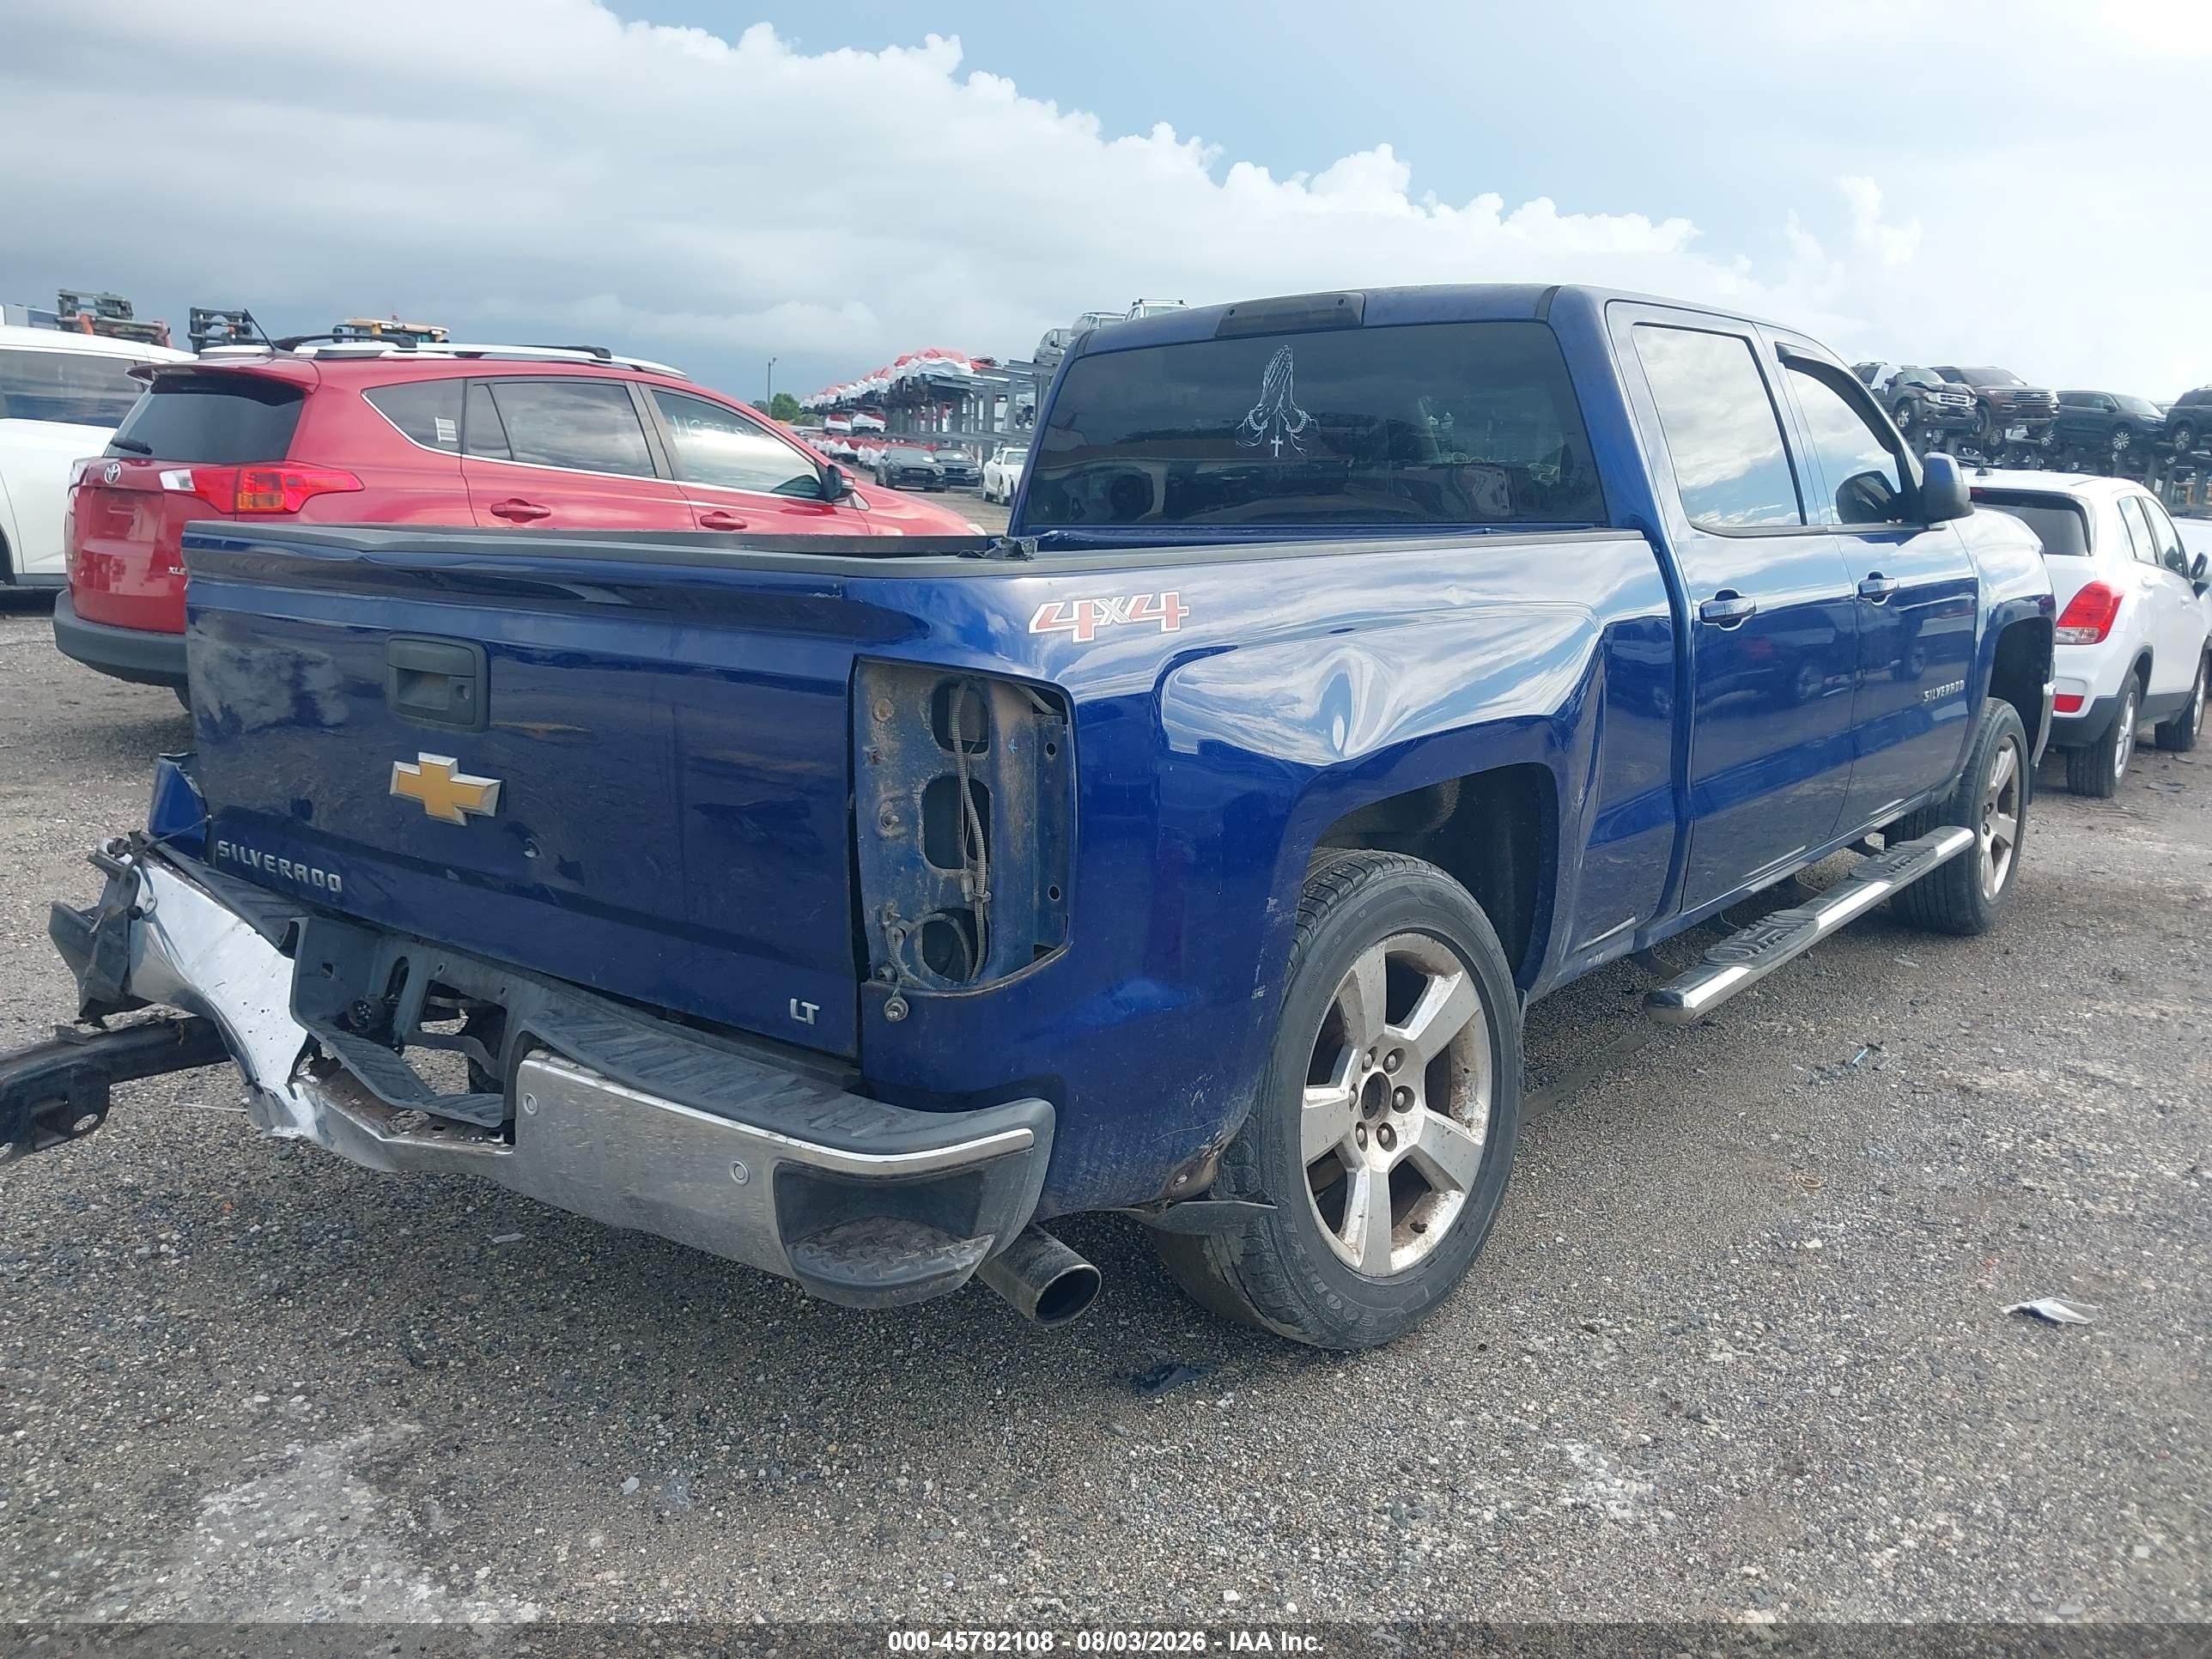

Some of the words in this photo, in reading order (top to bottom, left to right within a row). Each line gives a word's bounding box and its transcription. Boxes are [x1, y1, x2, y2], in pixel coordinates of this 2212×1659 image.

[1923, 679, 1965, 702] SILVERADO
[216, 840, 343, 894] SILVERADO
[790, 998, 820, 1024] LT
